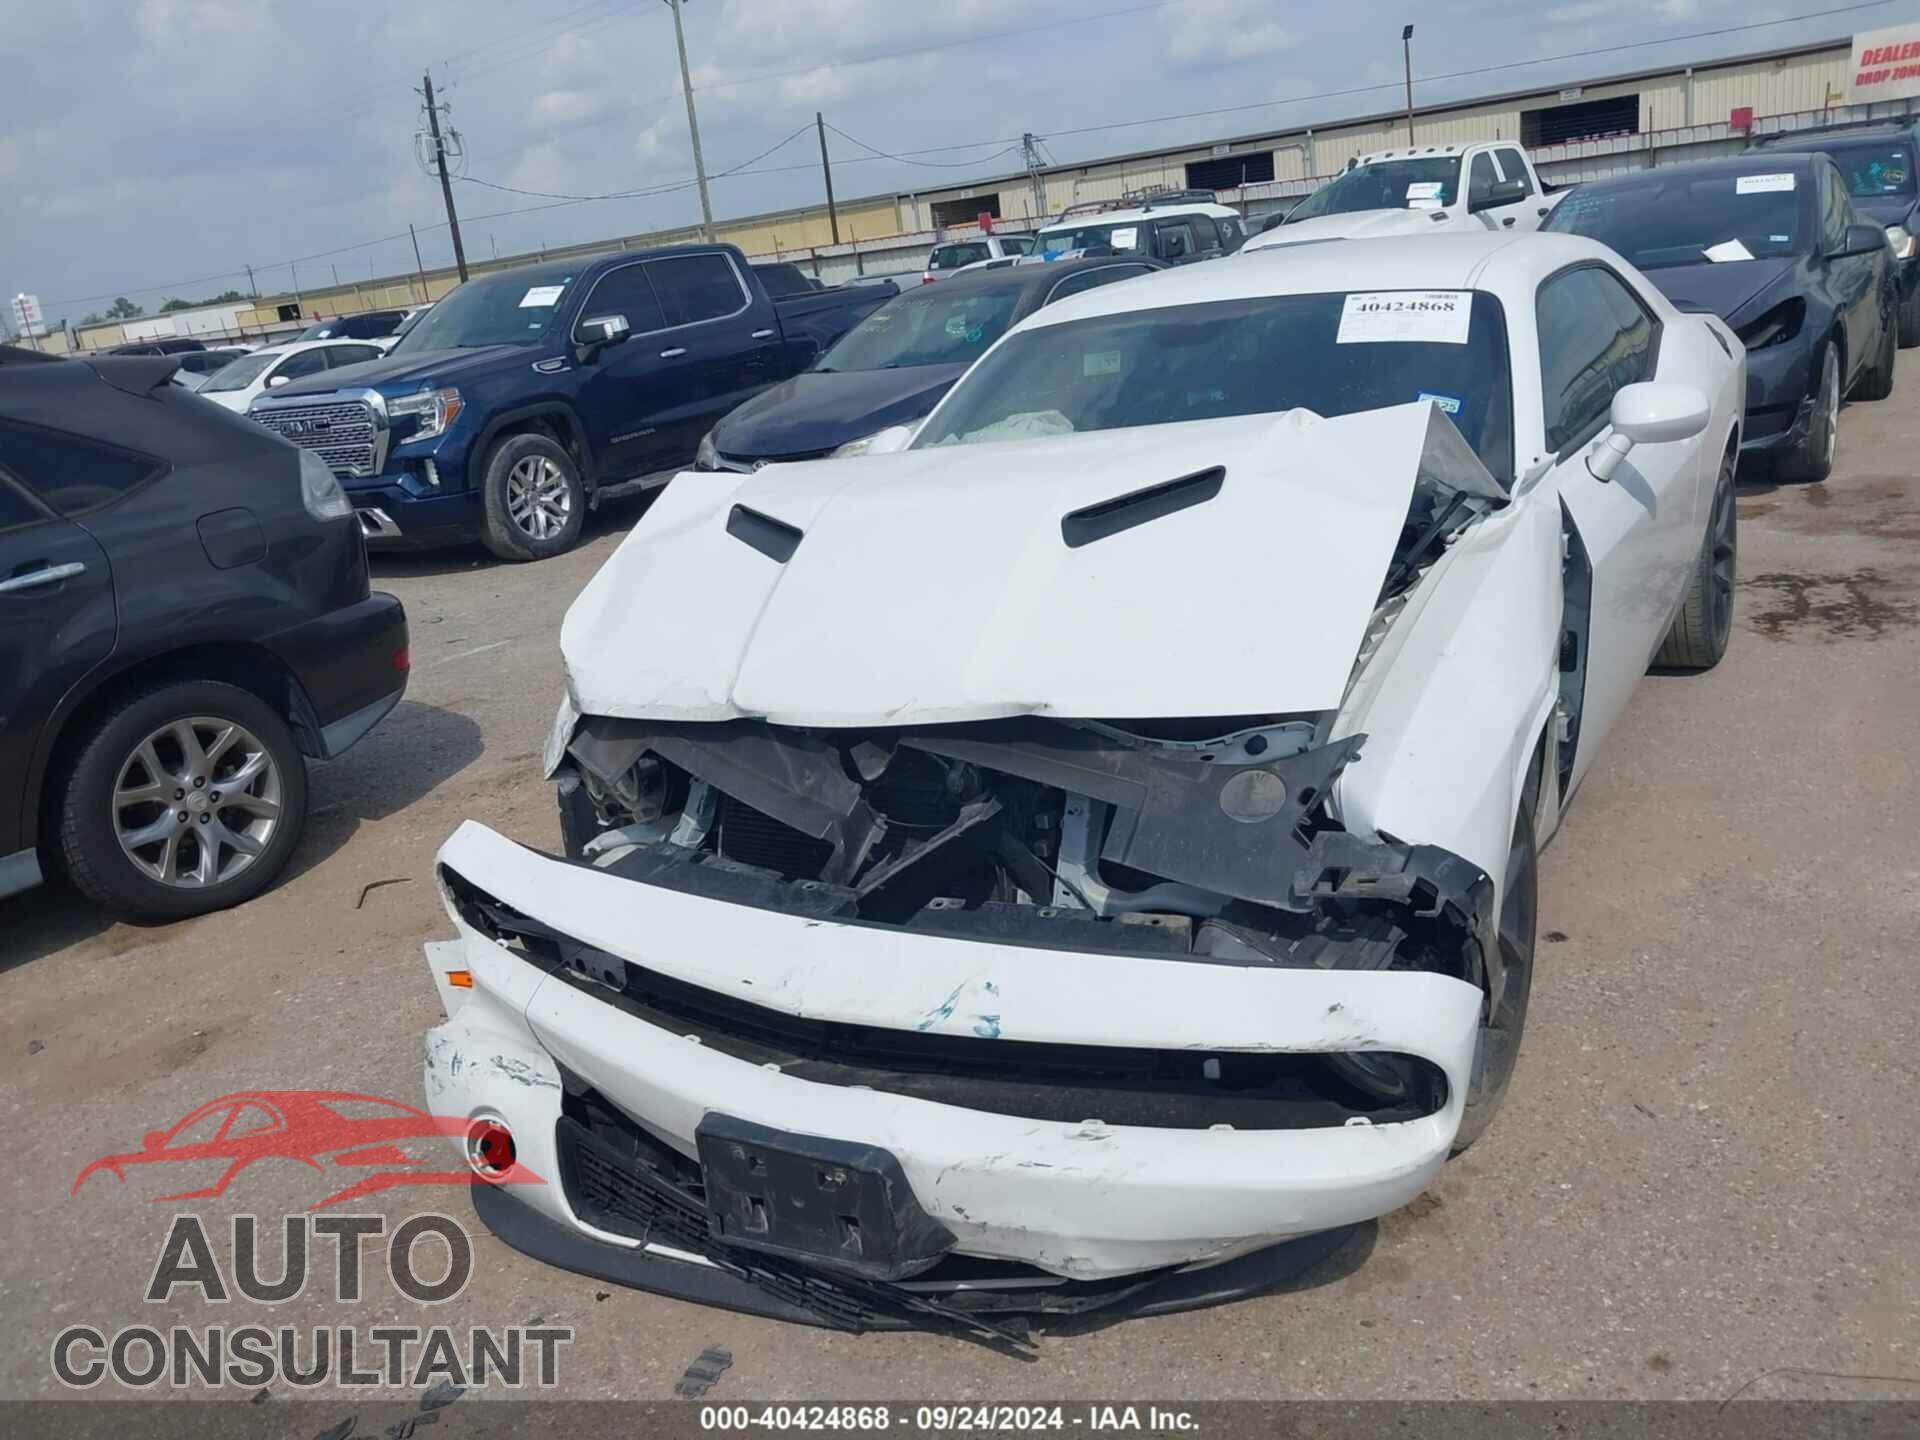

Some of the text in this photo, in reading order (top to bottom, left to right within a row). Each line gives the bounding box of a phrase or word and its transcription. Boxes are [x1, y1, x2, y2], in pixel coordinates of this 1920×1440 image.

[1856, 69, 1890, 86] DROP
[1356, 302, 1455, 313] 40424868
[281, 418, 330, 436] GMC
